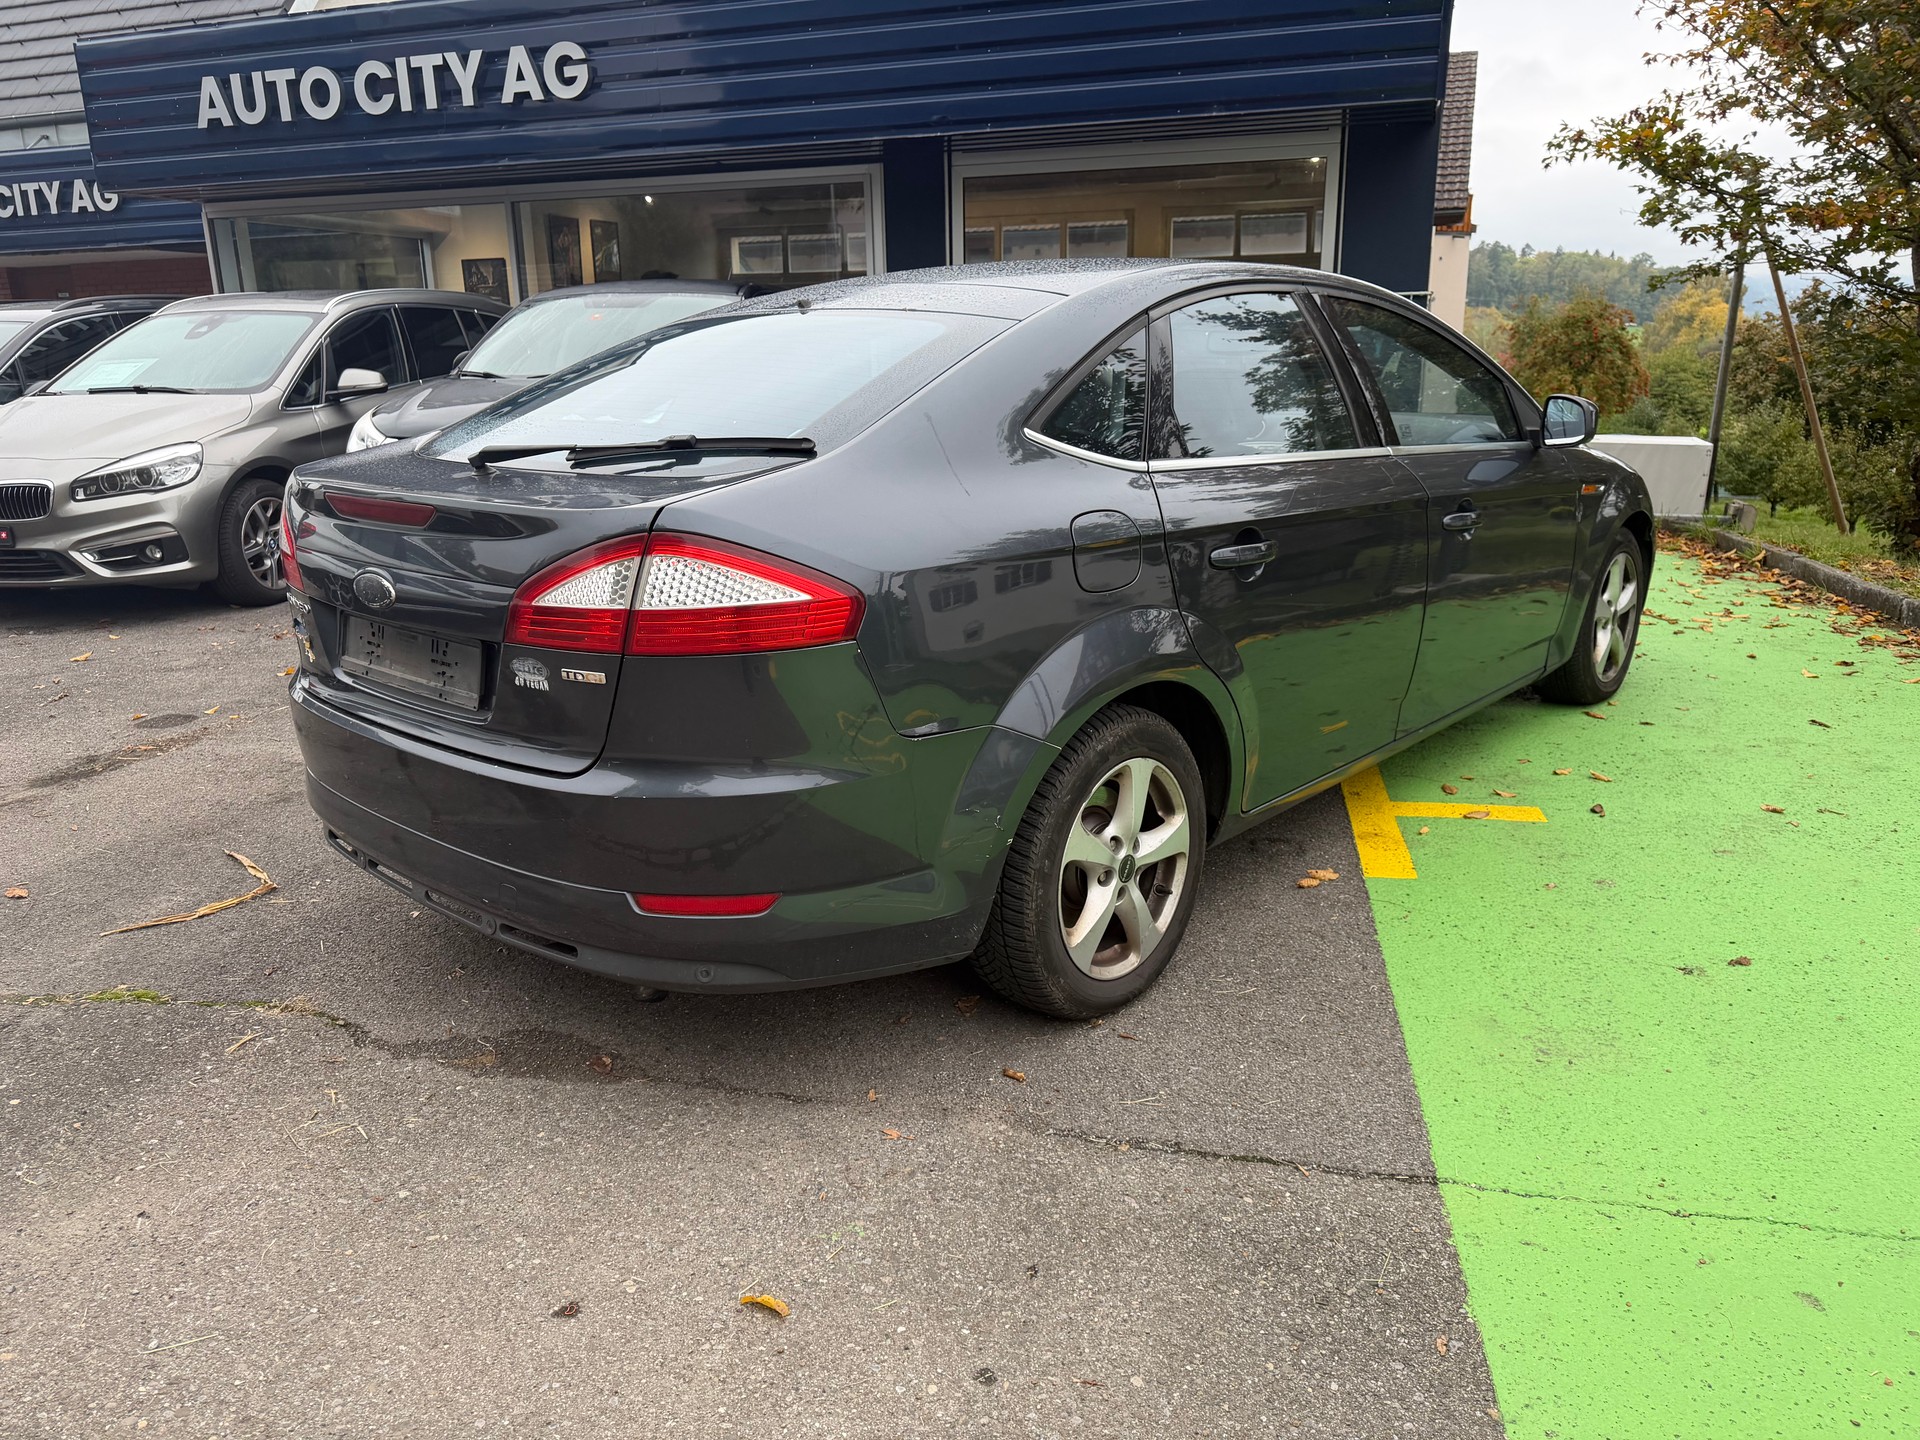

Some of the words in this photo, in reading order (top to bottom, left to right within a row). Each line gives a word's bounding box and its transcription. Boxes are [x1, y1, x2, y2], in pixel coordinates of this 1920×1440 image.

[198, 65, 341, 129] AUTO
[353, 49, 484, 116] CITY
[501, 41, 590, 104] AG
